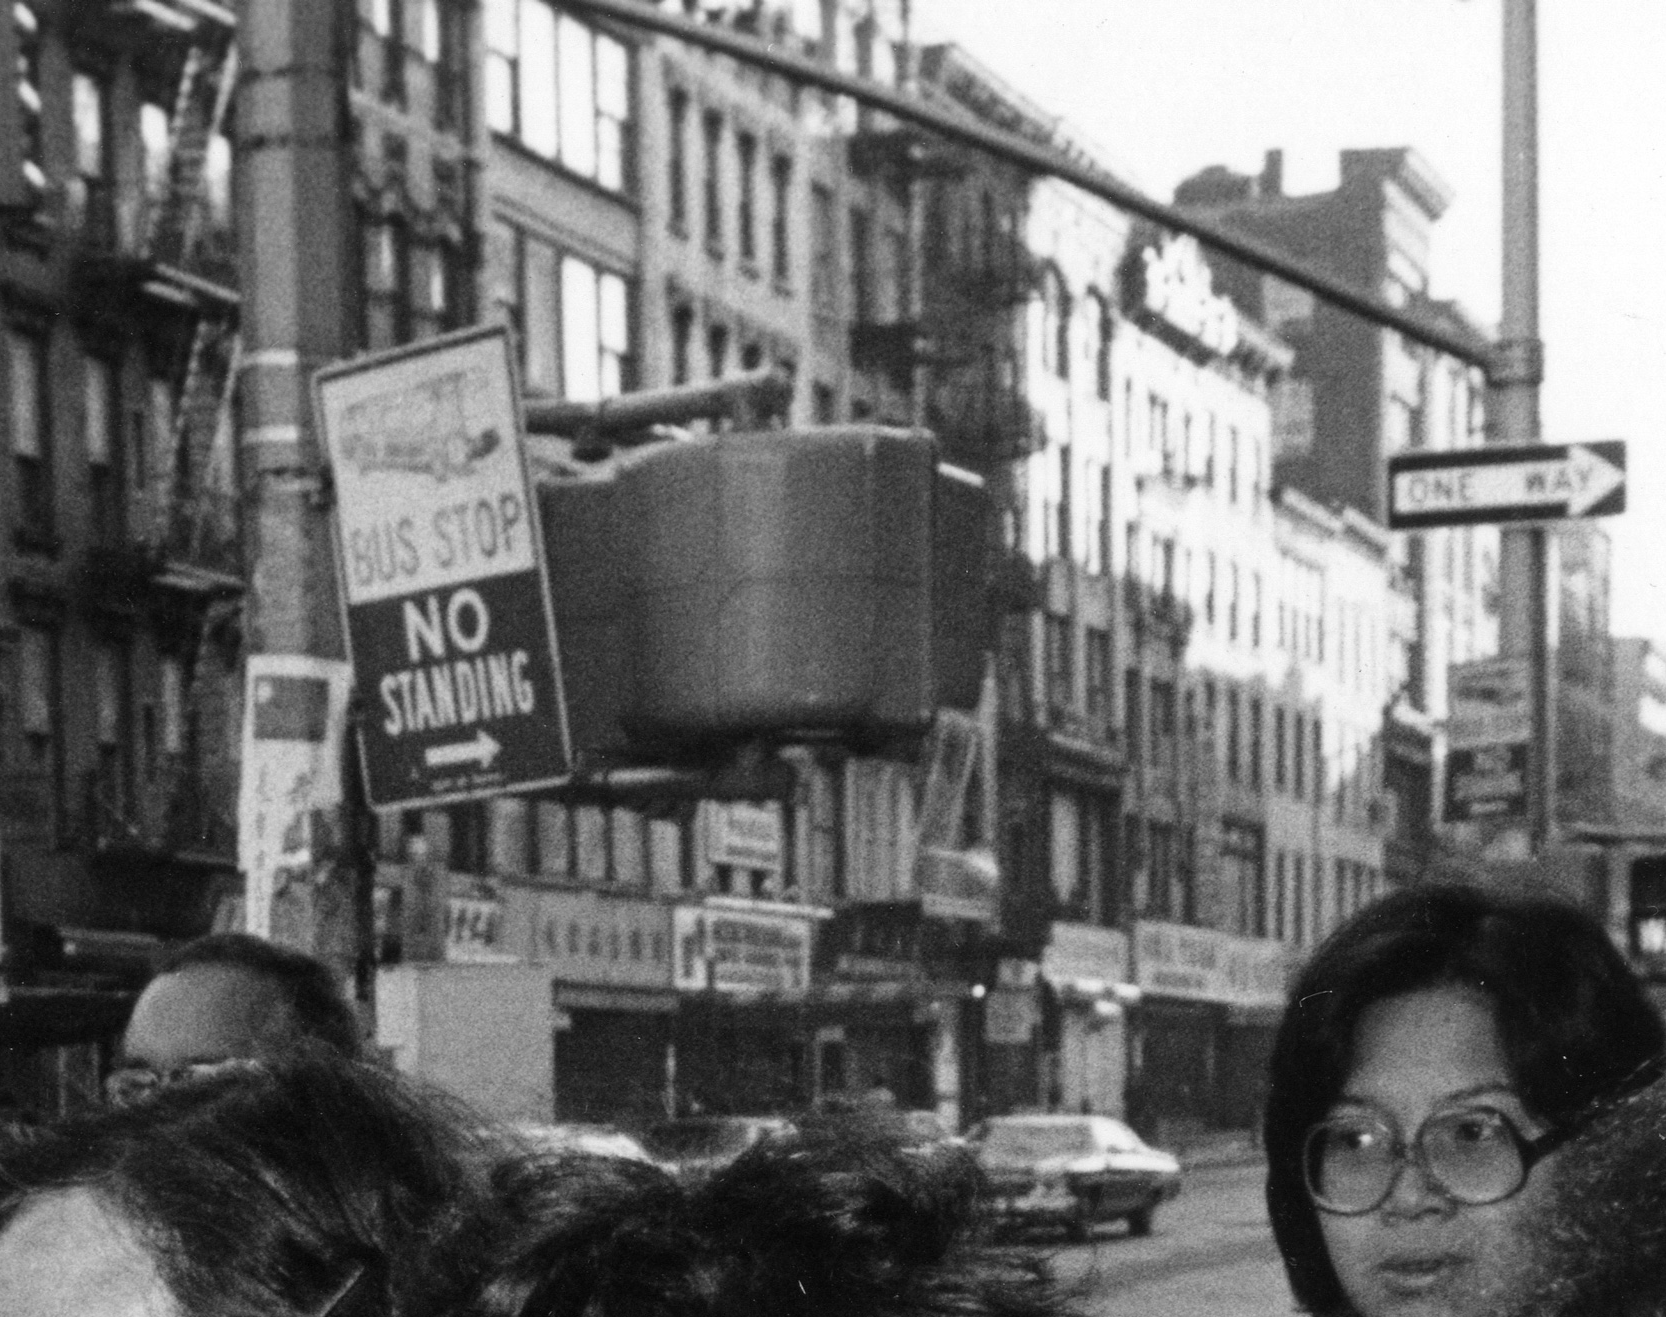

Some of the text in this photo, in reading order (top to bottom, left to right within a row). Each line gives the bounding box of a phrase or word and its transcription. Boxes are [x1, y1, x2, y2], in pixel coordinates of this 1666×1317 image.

[1408, 463, 1594, 504] ONE WAY
[349, 493, 520, 585] BUS STOP
[403, 588, 489, 663] NO
[379, 650, 535, 736] STANDING
